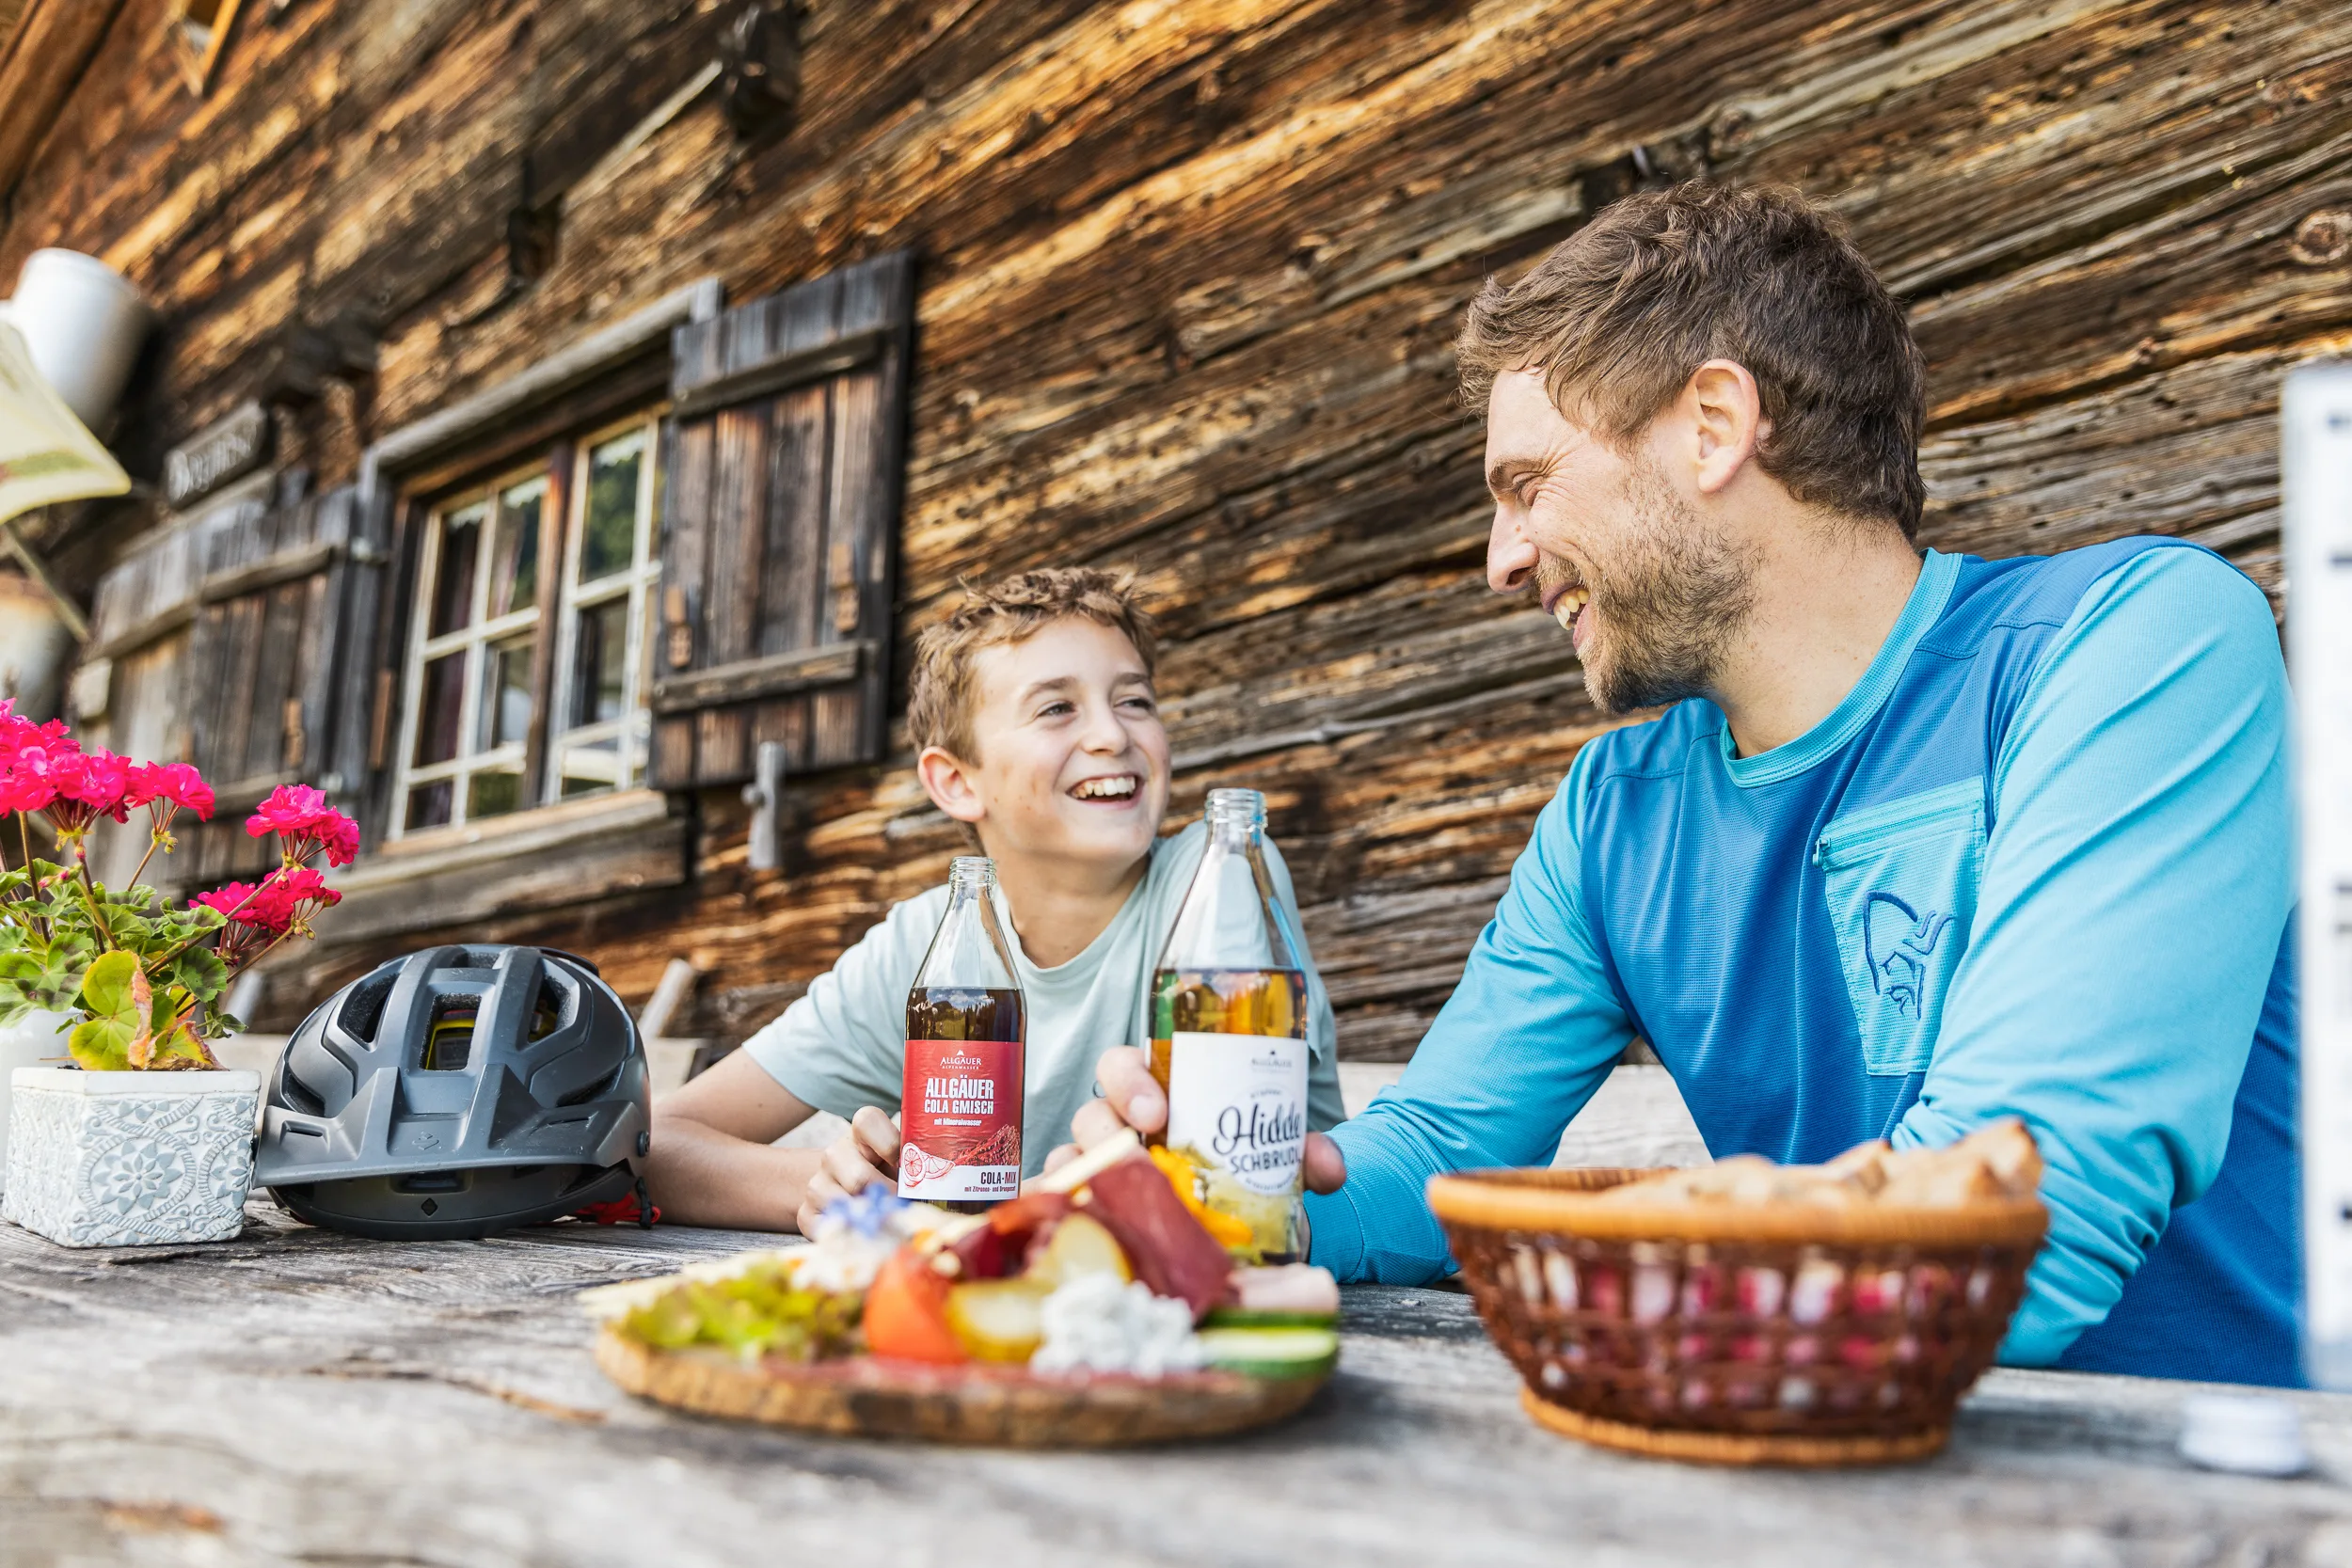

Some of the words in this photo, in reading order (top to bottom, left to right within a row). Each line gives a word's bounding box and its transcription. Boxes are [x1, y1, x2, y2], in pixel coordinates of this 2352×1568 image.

[940, 1056, 982, 1067] ALLGÄUER
[925, 1074, 994, 1100] ALLGÄUER
[924, 1099, 949, 1114] COLA
[952, 1100, 994, 1115] GMISCH
[933, 1117, 943, 1126] mit
[943, 1117, 982, 1127] Mineralwasser
